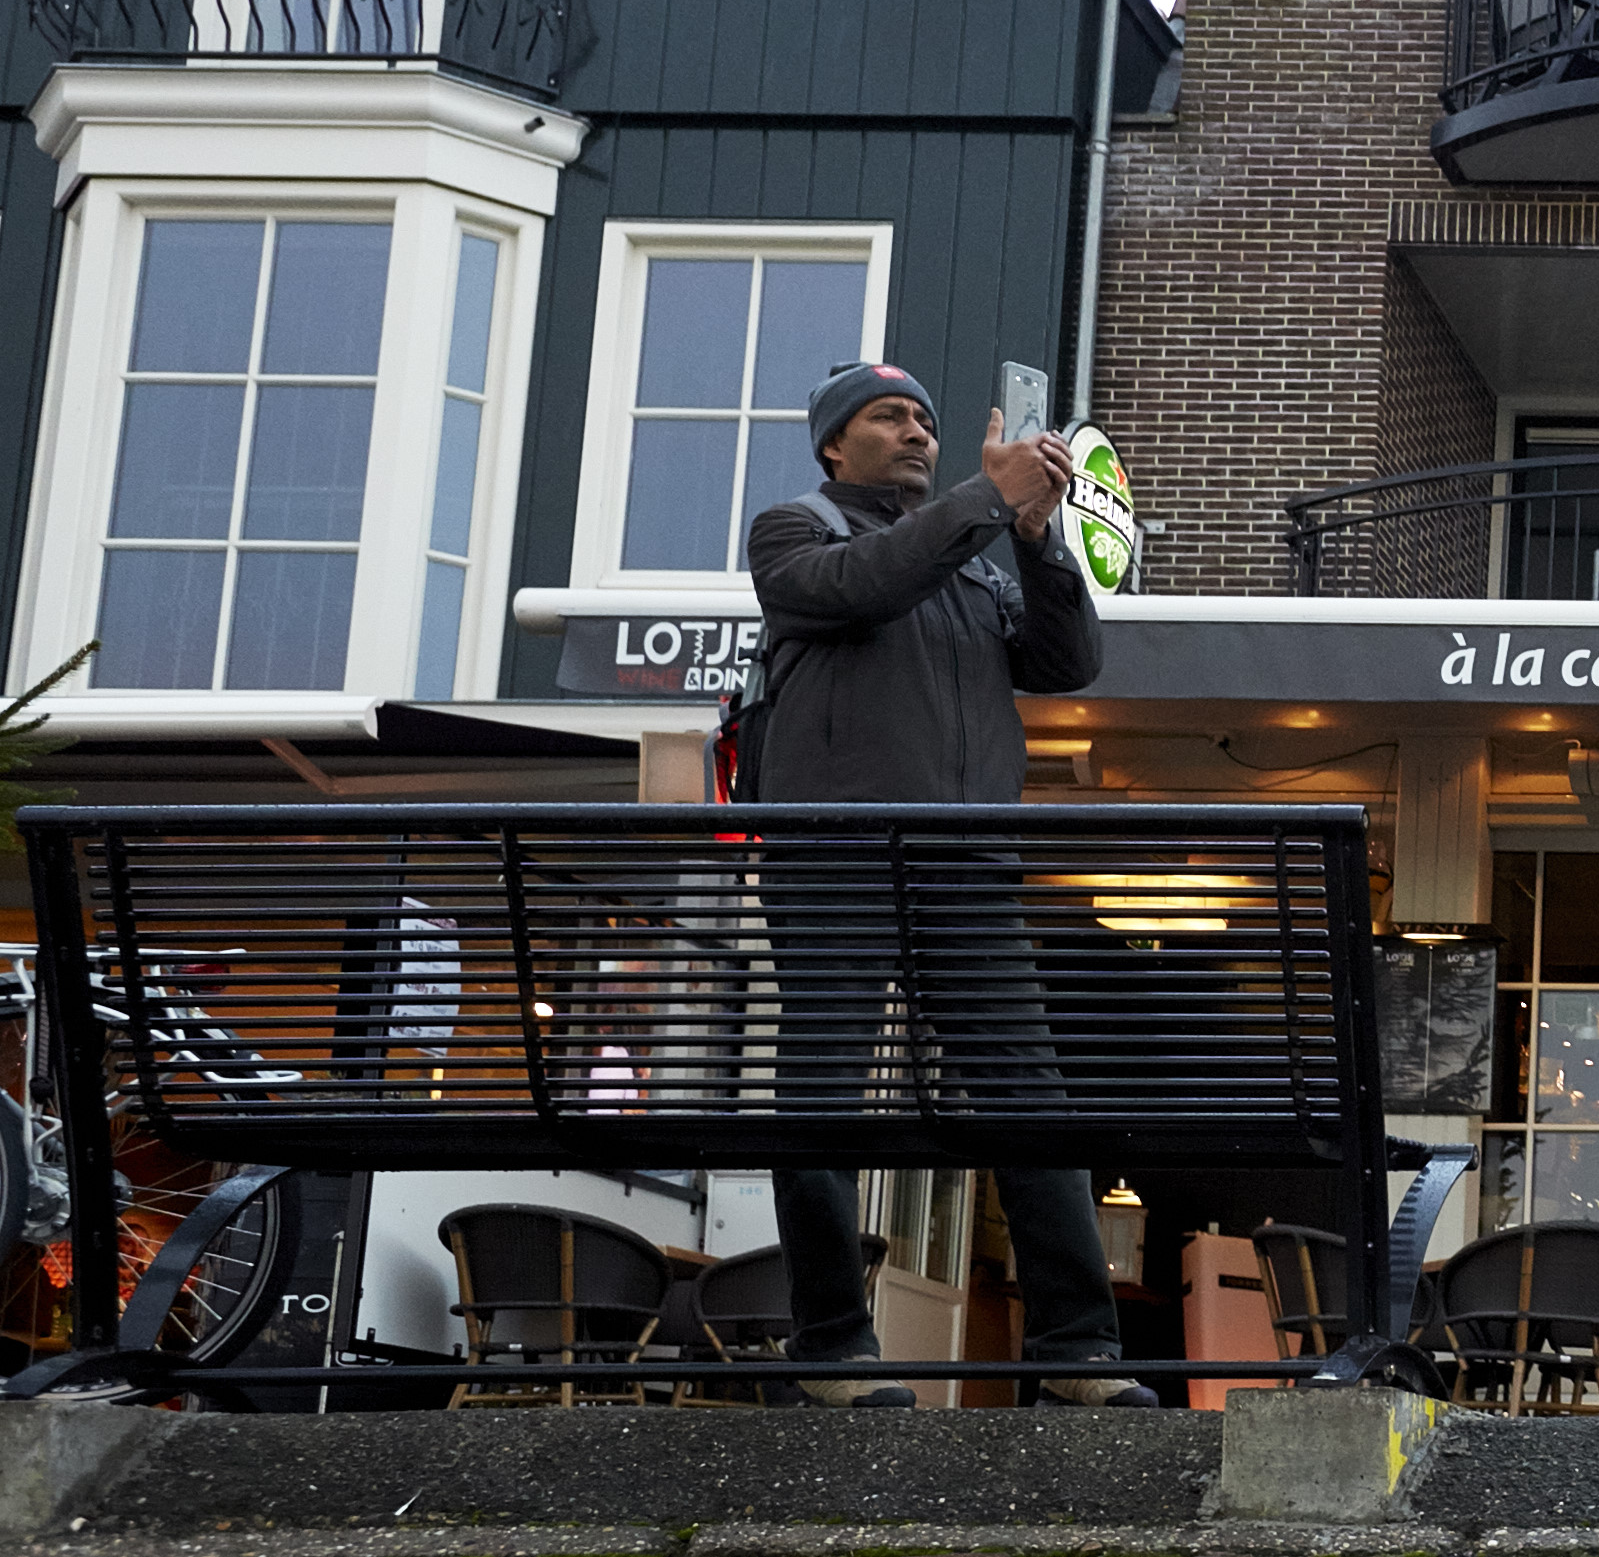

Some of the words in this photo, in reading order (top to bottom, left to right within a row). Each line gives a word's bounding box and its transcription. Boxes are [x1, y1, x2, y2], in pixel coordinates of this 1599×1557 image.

[616, 621, 761, 665] LOTJE
[1441, 632, 1476, 685] à
[1492, 632, 1545, 687] la
[703, 667, 750, 691] DIN
